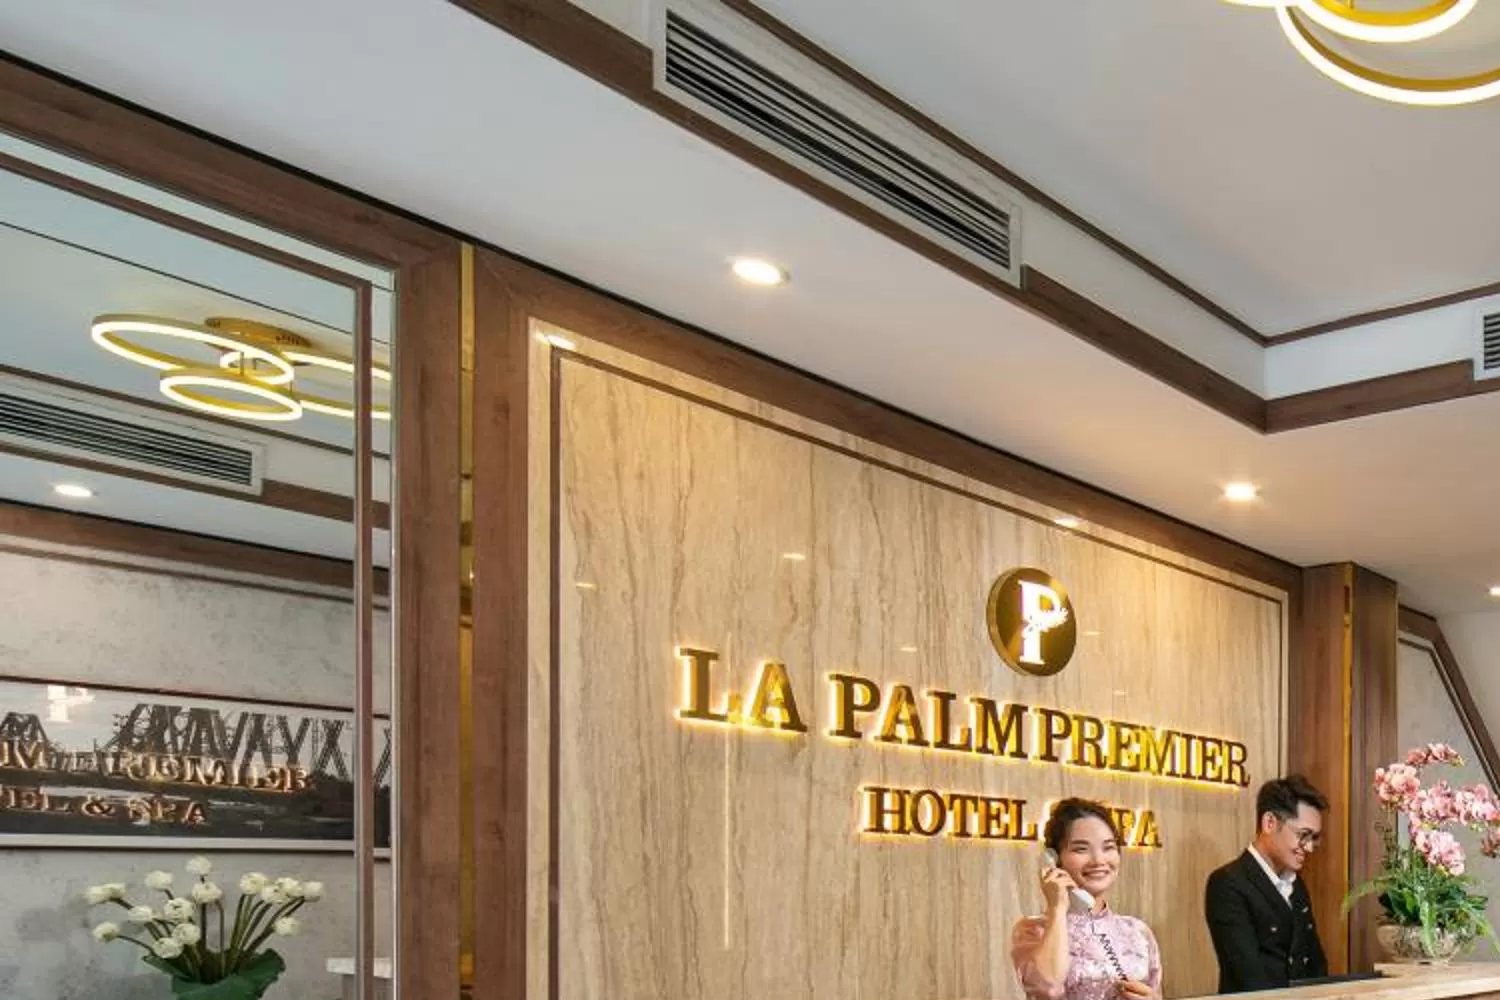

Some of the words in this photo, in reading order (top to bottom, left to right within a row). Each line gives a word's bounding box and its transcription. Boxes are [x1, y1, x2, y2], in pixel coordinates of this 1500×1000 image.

[676, 646, 808, 734] LA
[826, 672, 1029, 761] PALM
[1031, 706, 1250, 788] PREMIER
[862, 785, 1038, 841] HOTEL
[1106, 806, 1163, 848] PA
